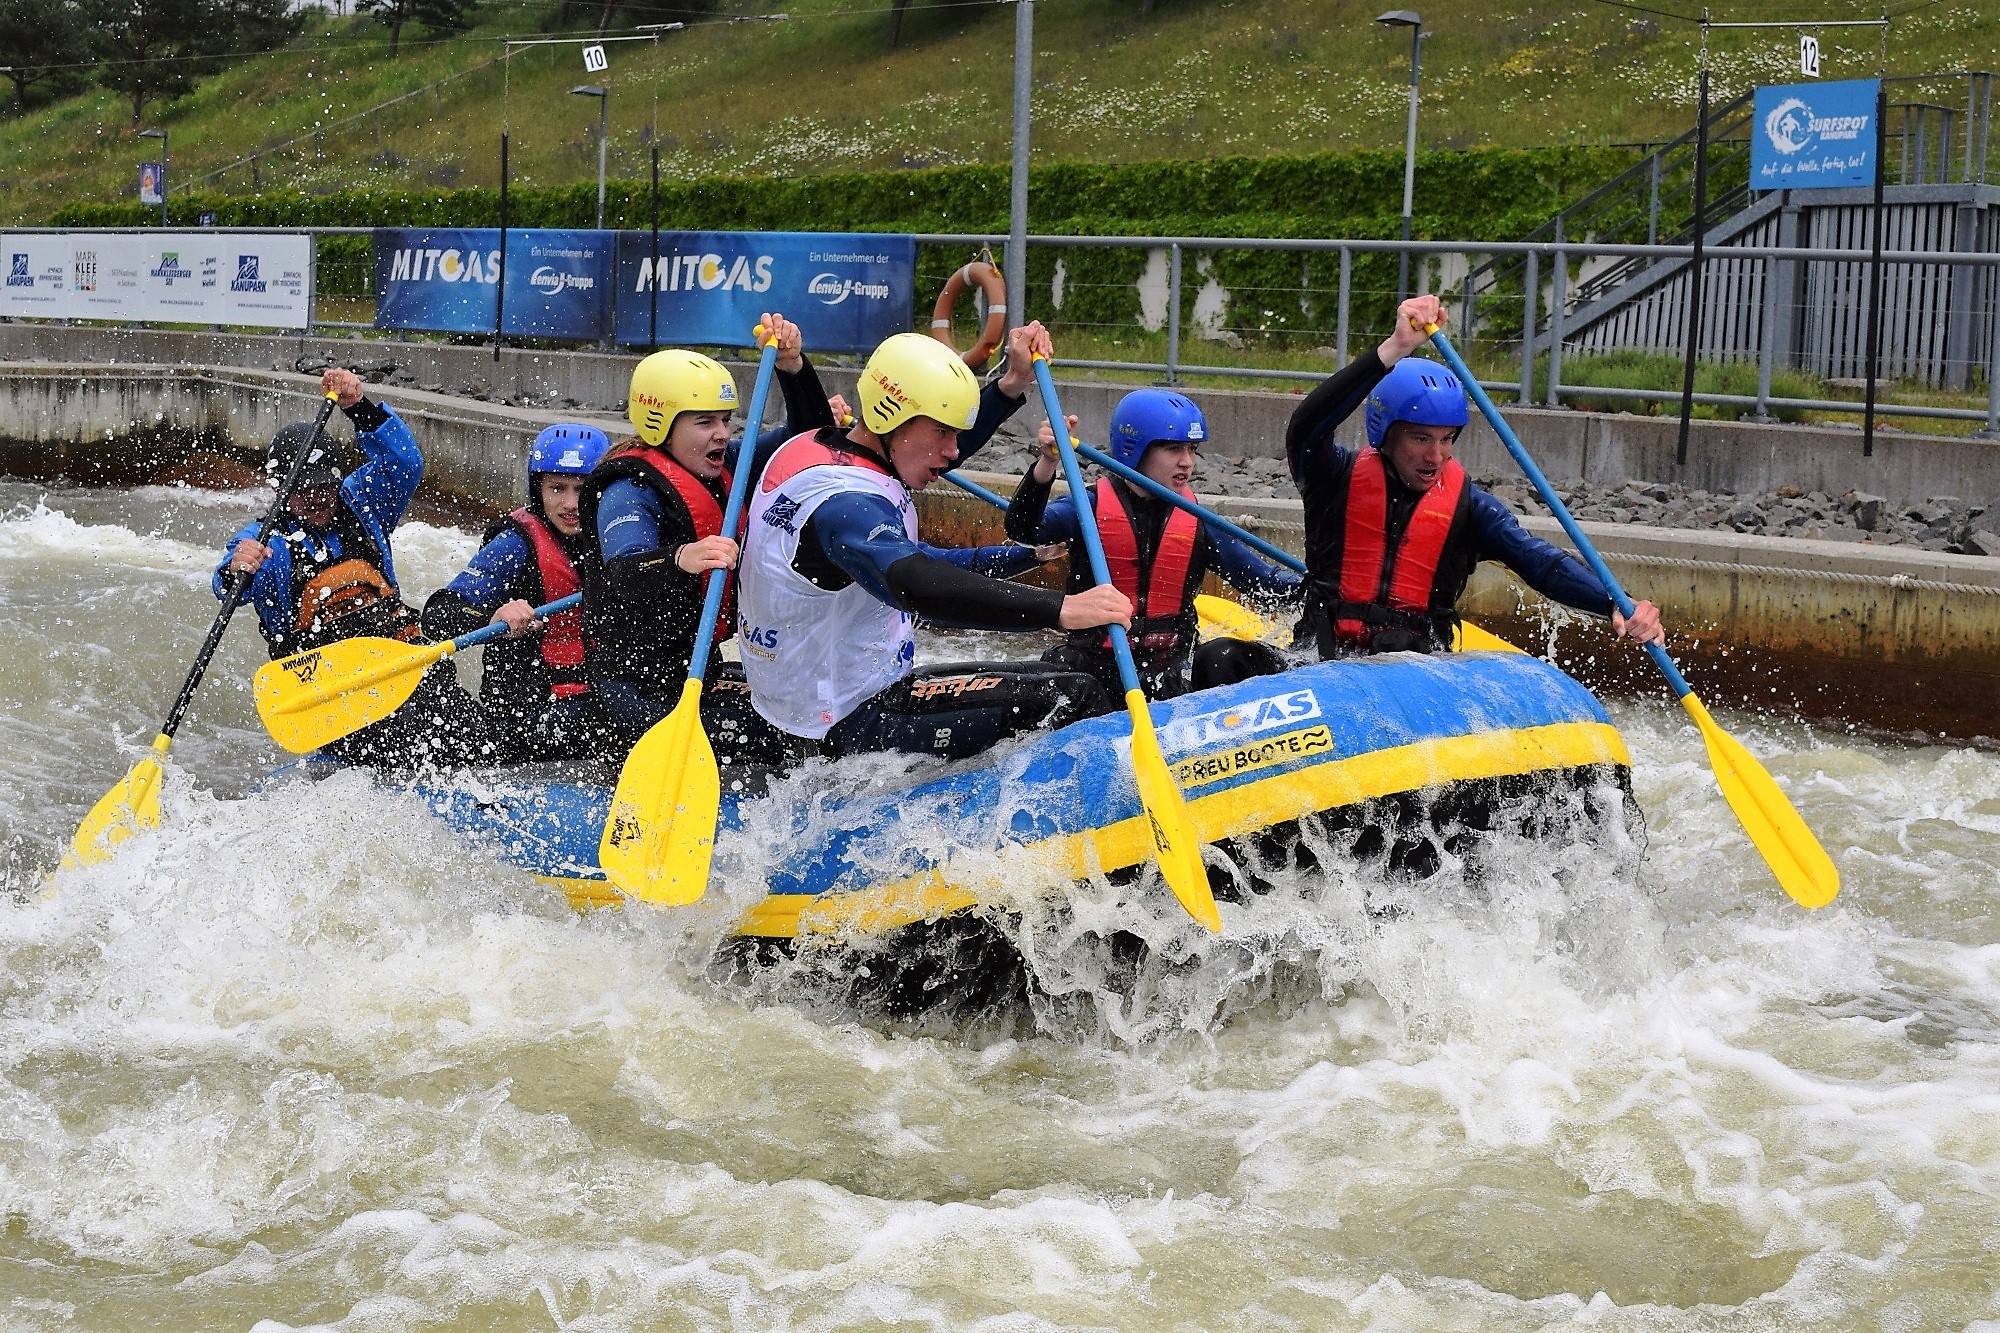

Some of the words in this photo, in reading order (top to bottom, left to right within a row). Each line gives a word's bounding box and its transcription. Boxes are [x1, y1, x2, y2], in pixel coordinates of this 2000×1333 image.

[586, 49, 604, 68] 10
[1803, 40, 1817, 72] 12
[1807, 116, 1869, 132] SURFSPOT
[1761, 162, 1778, 178] Auf
[1781, 163, 1792, 174] die
[75, 251, 97, 261] MARK
[531, 247, 541, 257] Ein
[542, 247, 583, 258] Unternehmen
[583, 249, 594, 258] der
[809, 252, 821, 262] Ein
[822, 252, 875, 263] Unternehmen
[876, 254, 889, 264] der
[75, 262, 97, 274] KLEE
[390, 249, 501, 284] MITGAS
[636, 254, 774, 293] MITGAS
[75, 274, 97, 285] BERG
[231, 279, 267, 293] KANUPARK
[281, 651, 322, 671] KANUPARK
[934, 728, 952, 748] 56
[1234, 737, 1302, 770] BOOTE
